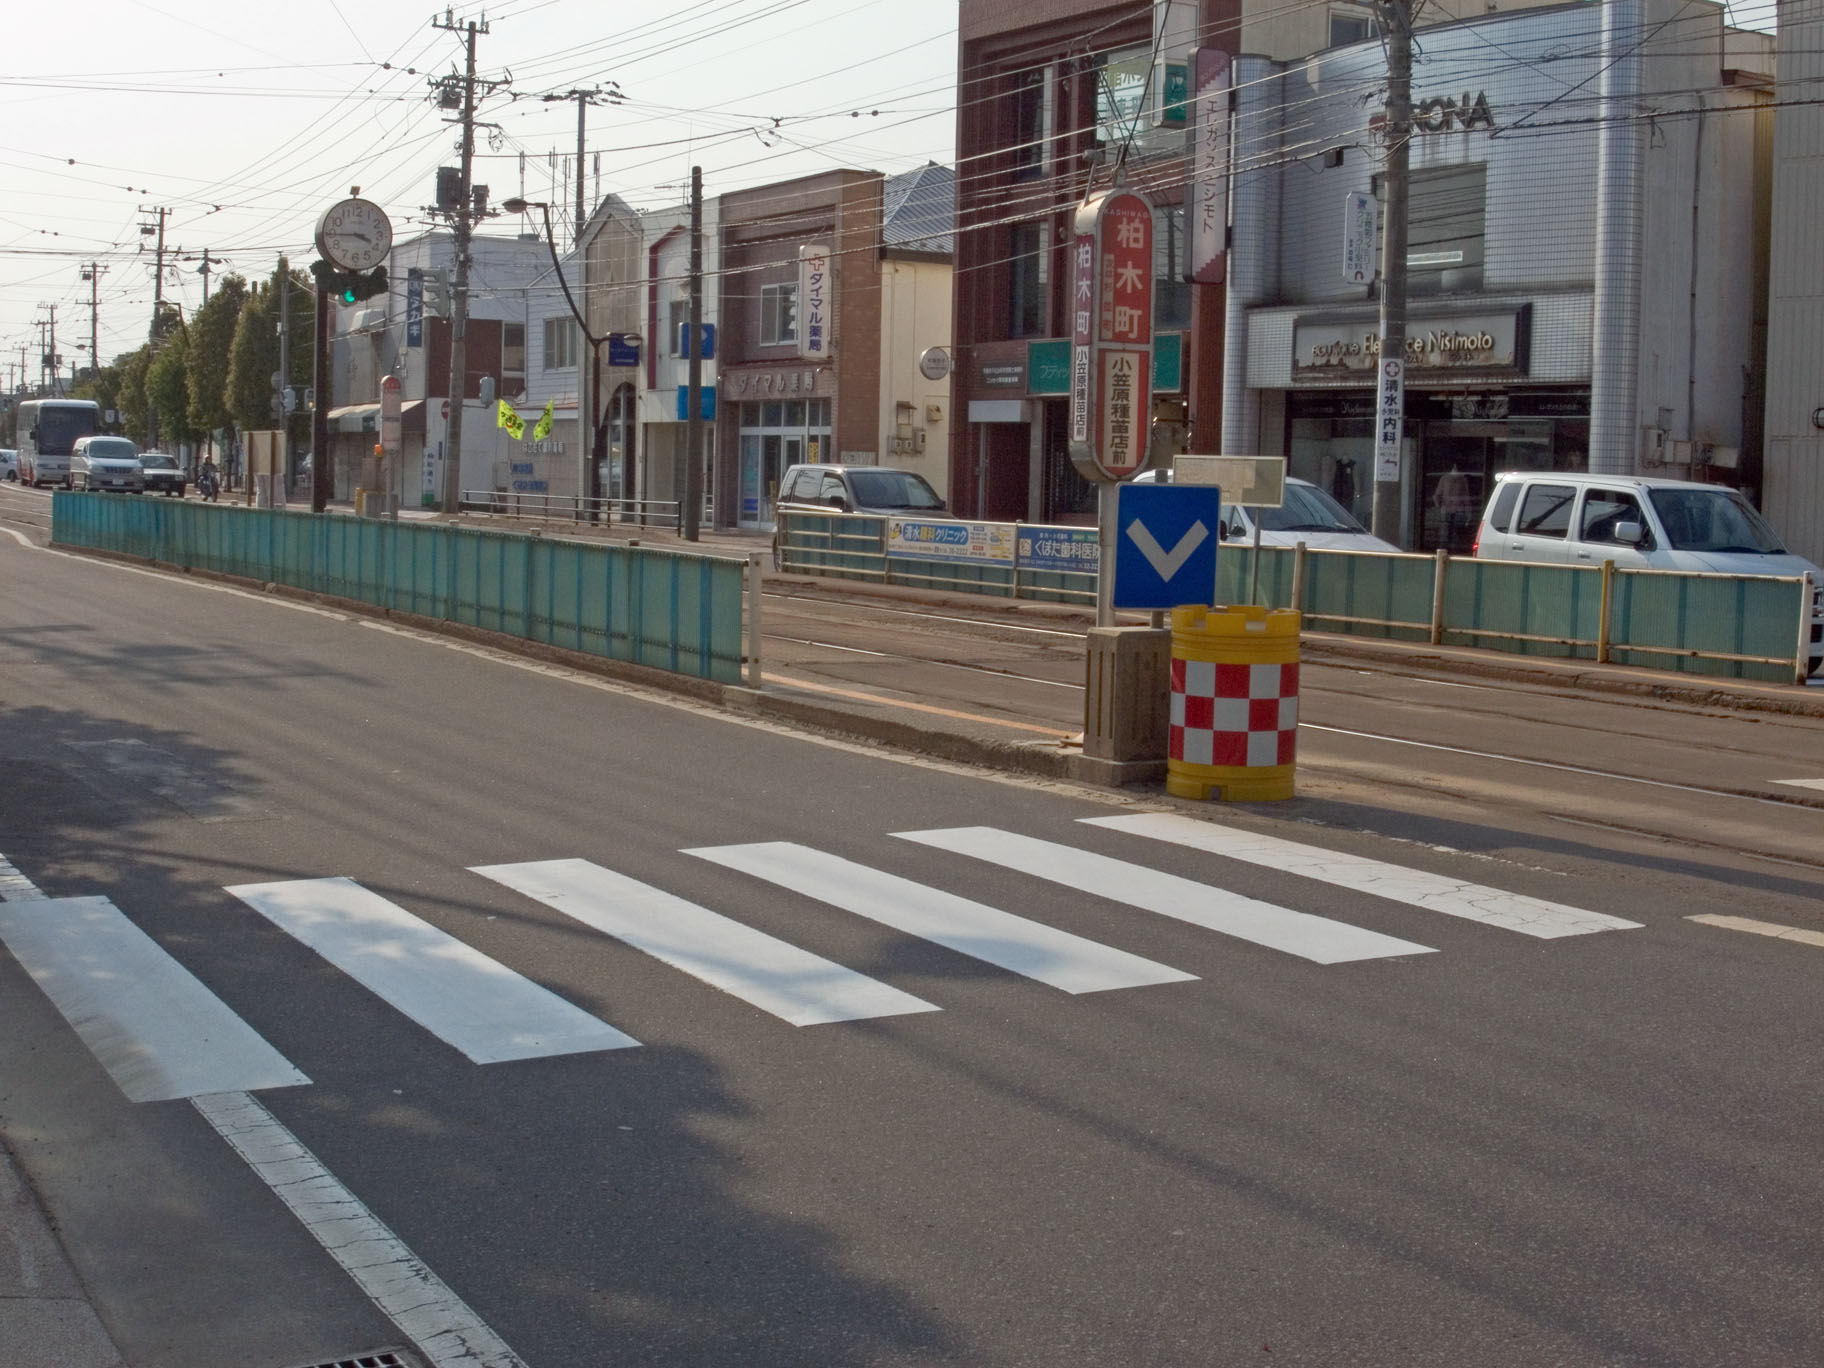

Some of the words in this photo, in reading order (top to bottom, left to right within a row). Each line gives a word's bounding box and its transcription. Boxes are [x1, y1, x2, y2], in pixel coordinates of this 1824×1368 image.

[808, 272, 824, 352] ダイマル薬局
[1077, 243, 1092, 335] 柏木町
[1115, 217, 1145, 340] 柏木町
[1363, 333, 1424, 355] Elece
[1076, 350, 1088, 438] 小笠原種苗店前
[1110, 357, 1132, 465] 小笠原種苗店前
[904, 524, 968, 543] 清水眼科クリニック
